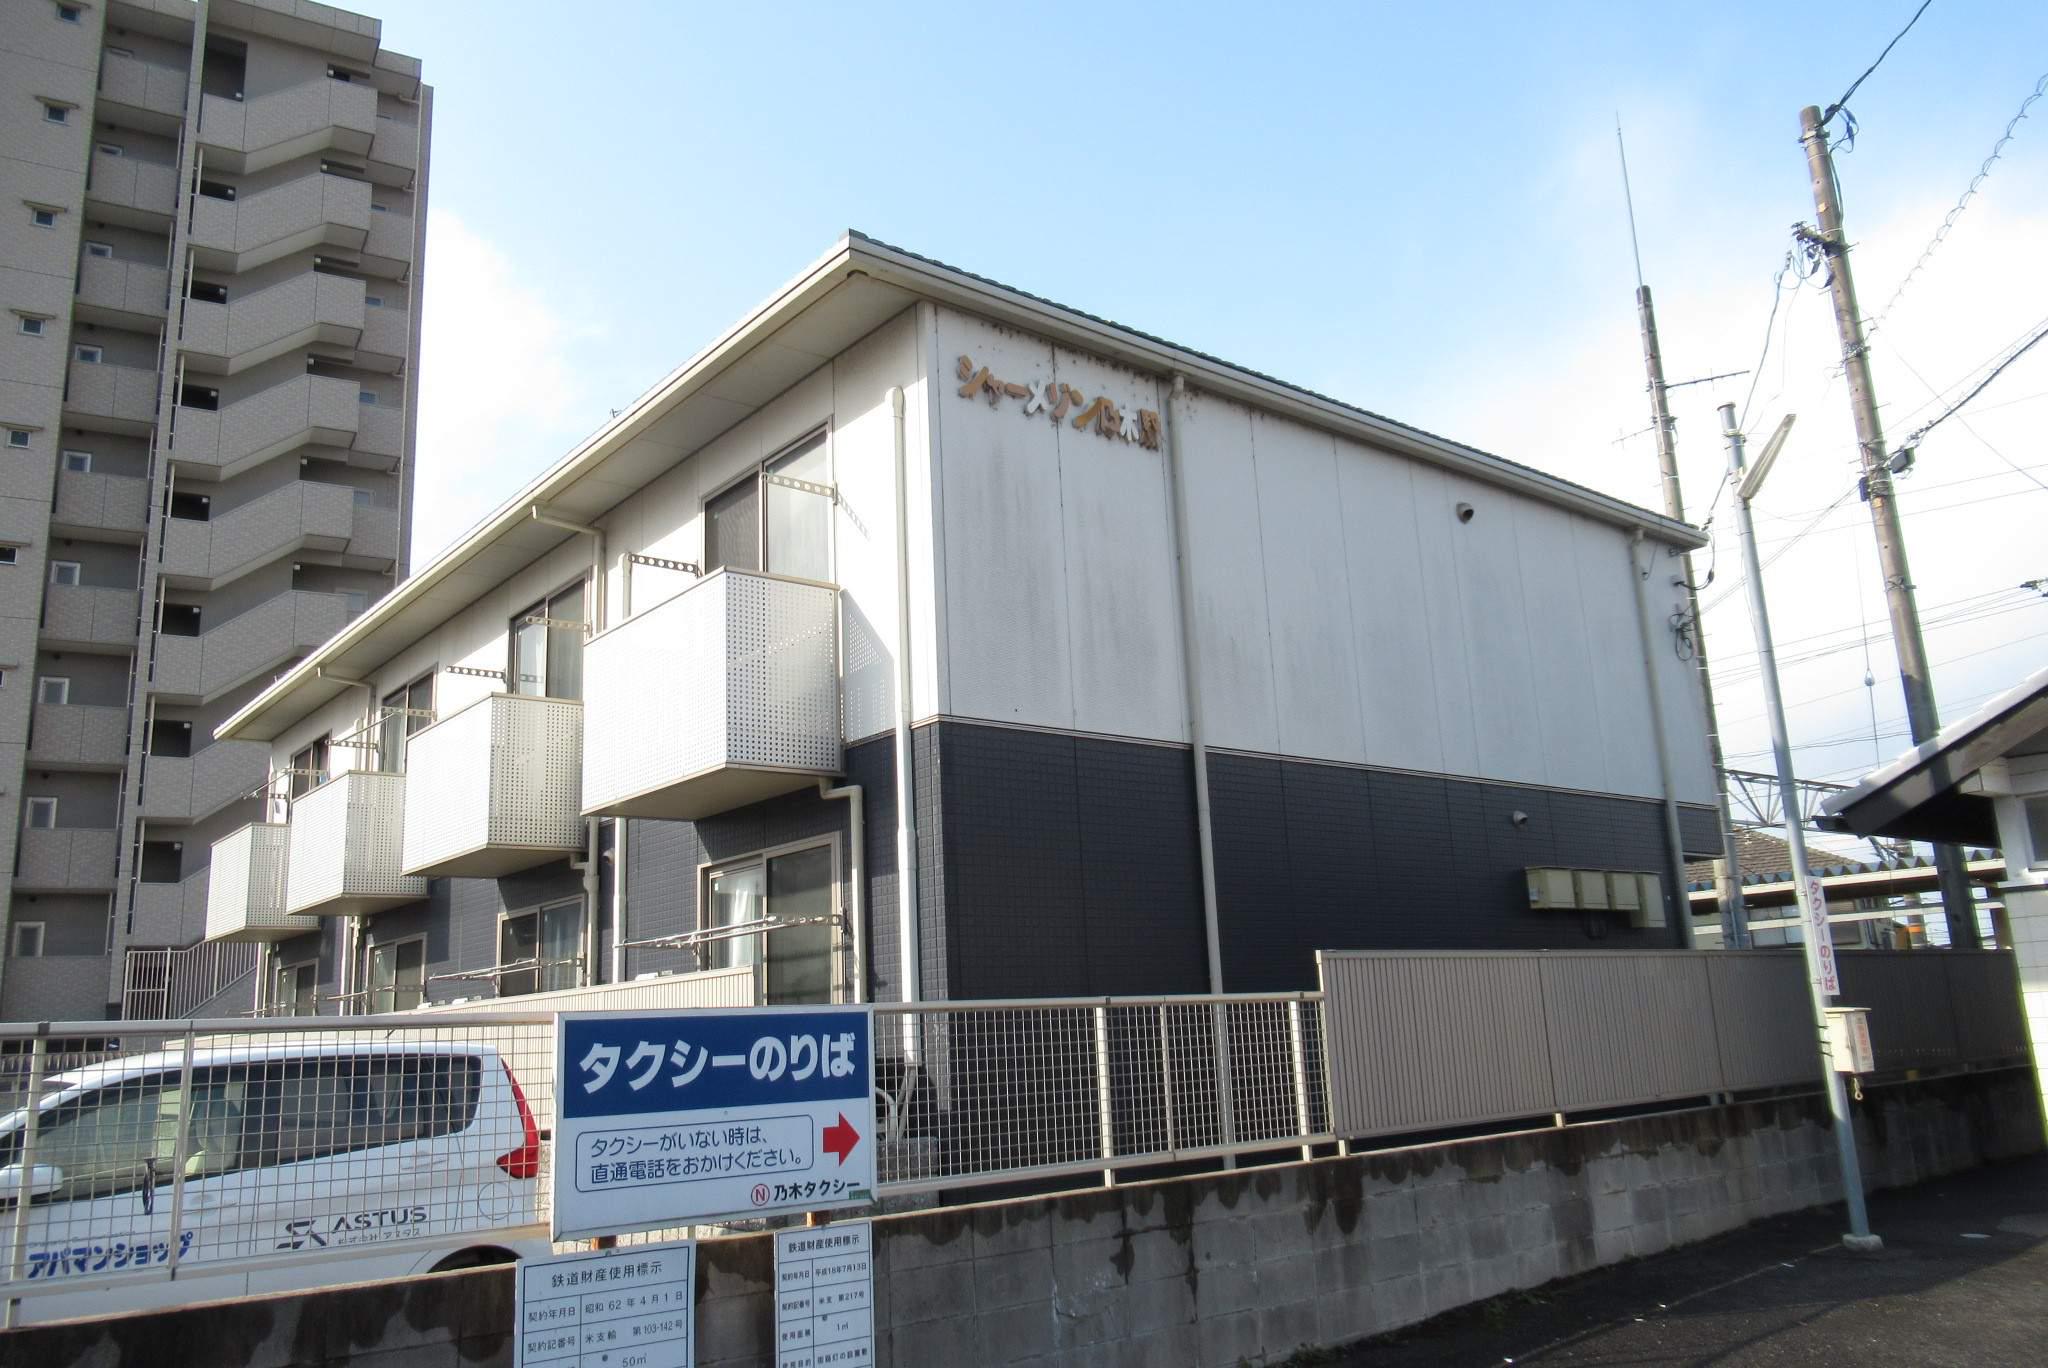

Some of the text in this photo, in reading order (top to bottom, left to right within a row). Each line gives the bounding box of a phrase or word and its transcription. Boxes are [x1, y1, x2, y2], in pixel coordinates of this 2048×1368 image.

[1809, 879, 1837, 991] タクシーのりば
[579, 1032, 857, 1095] タクシーのりば
[590, 1126, 768, 1158] タクシーがいない時は、
[590, 1148, 802, 1184] 直通電話をおかけください。
[774, 1179, 861, 1200] 乃木タクシー
[331, 1206, 428, 1234] ASTUS
[28, 1231, 194, 1279] アパマンショップ
[551, 1260, 663, 1289] 鉄道財産使用標示
[527, 1305, 577, 1323] 契約年月日
[527, 1335, 576, 1354] 契約記番号
